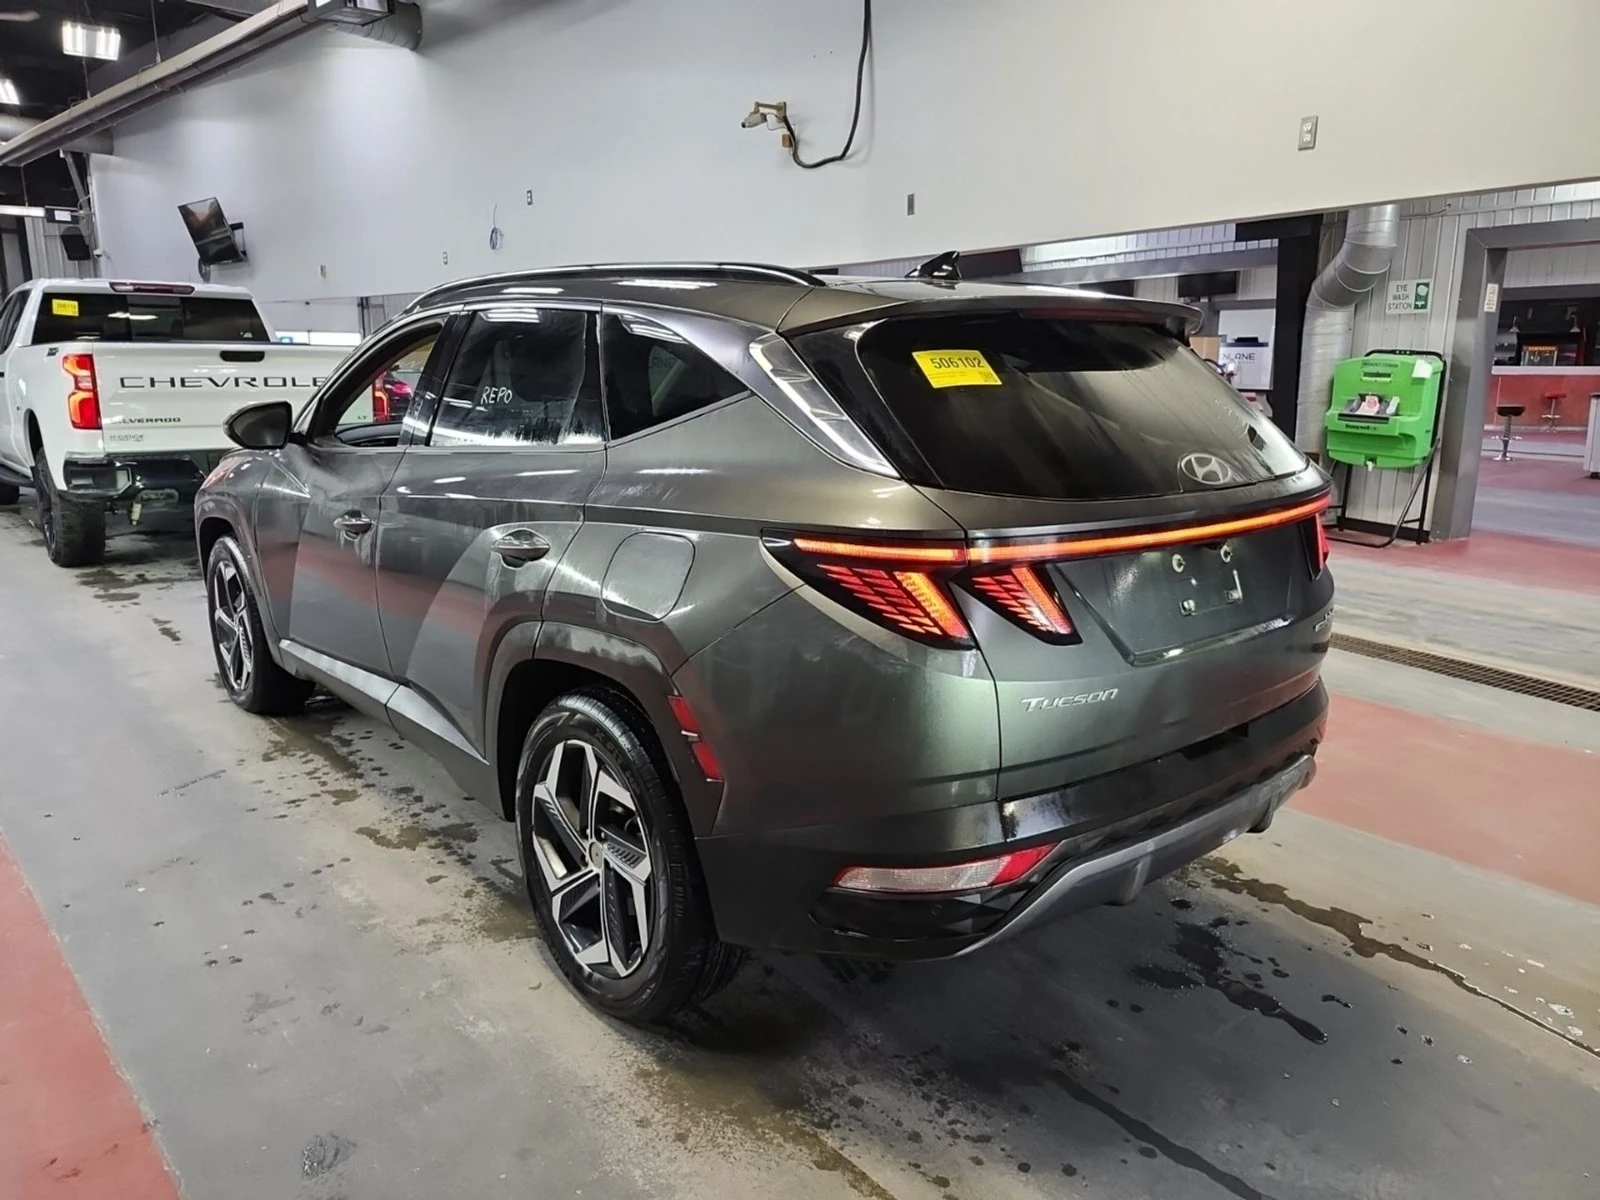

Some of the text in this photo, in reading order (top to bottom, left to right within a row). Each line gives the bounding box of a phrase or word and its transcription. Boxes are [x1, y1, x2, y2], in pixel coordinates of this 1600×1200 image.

[1396, 284, 1408, 292] EYE
[1392, 293, 1410, 301] WASH
[1387, 302, 1412, 310] STATION
[930, 357, 985, 369] 506102
[480, 385, 513, 404] REPO
